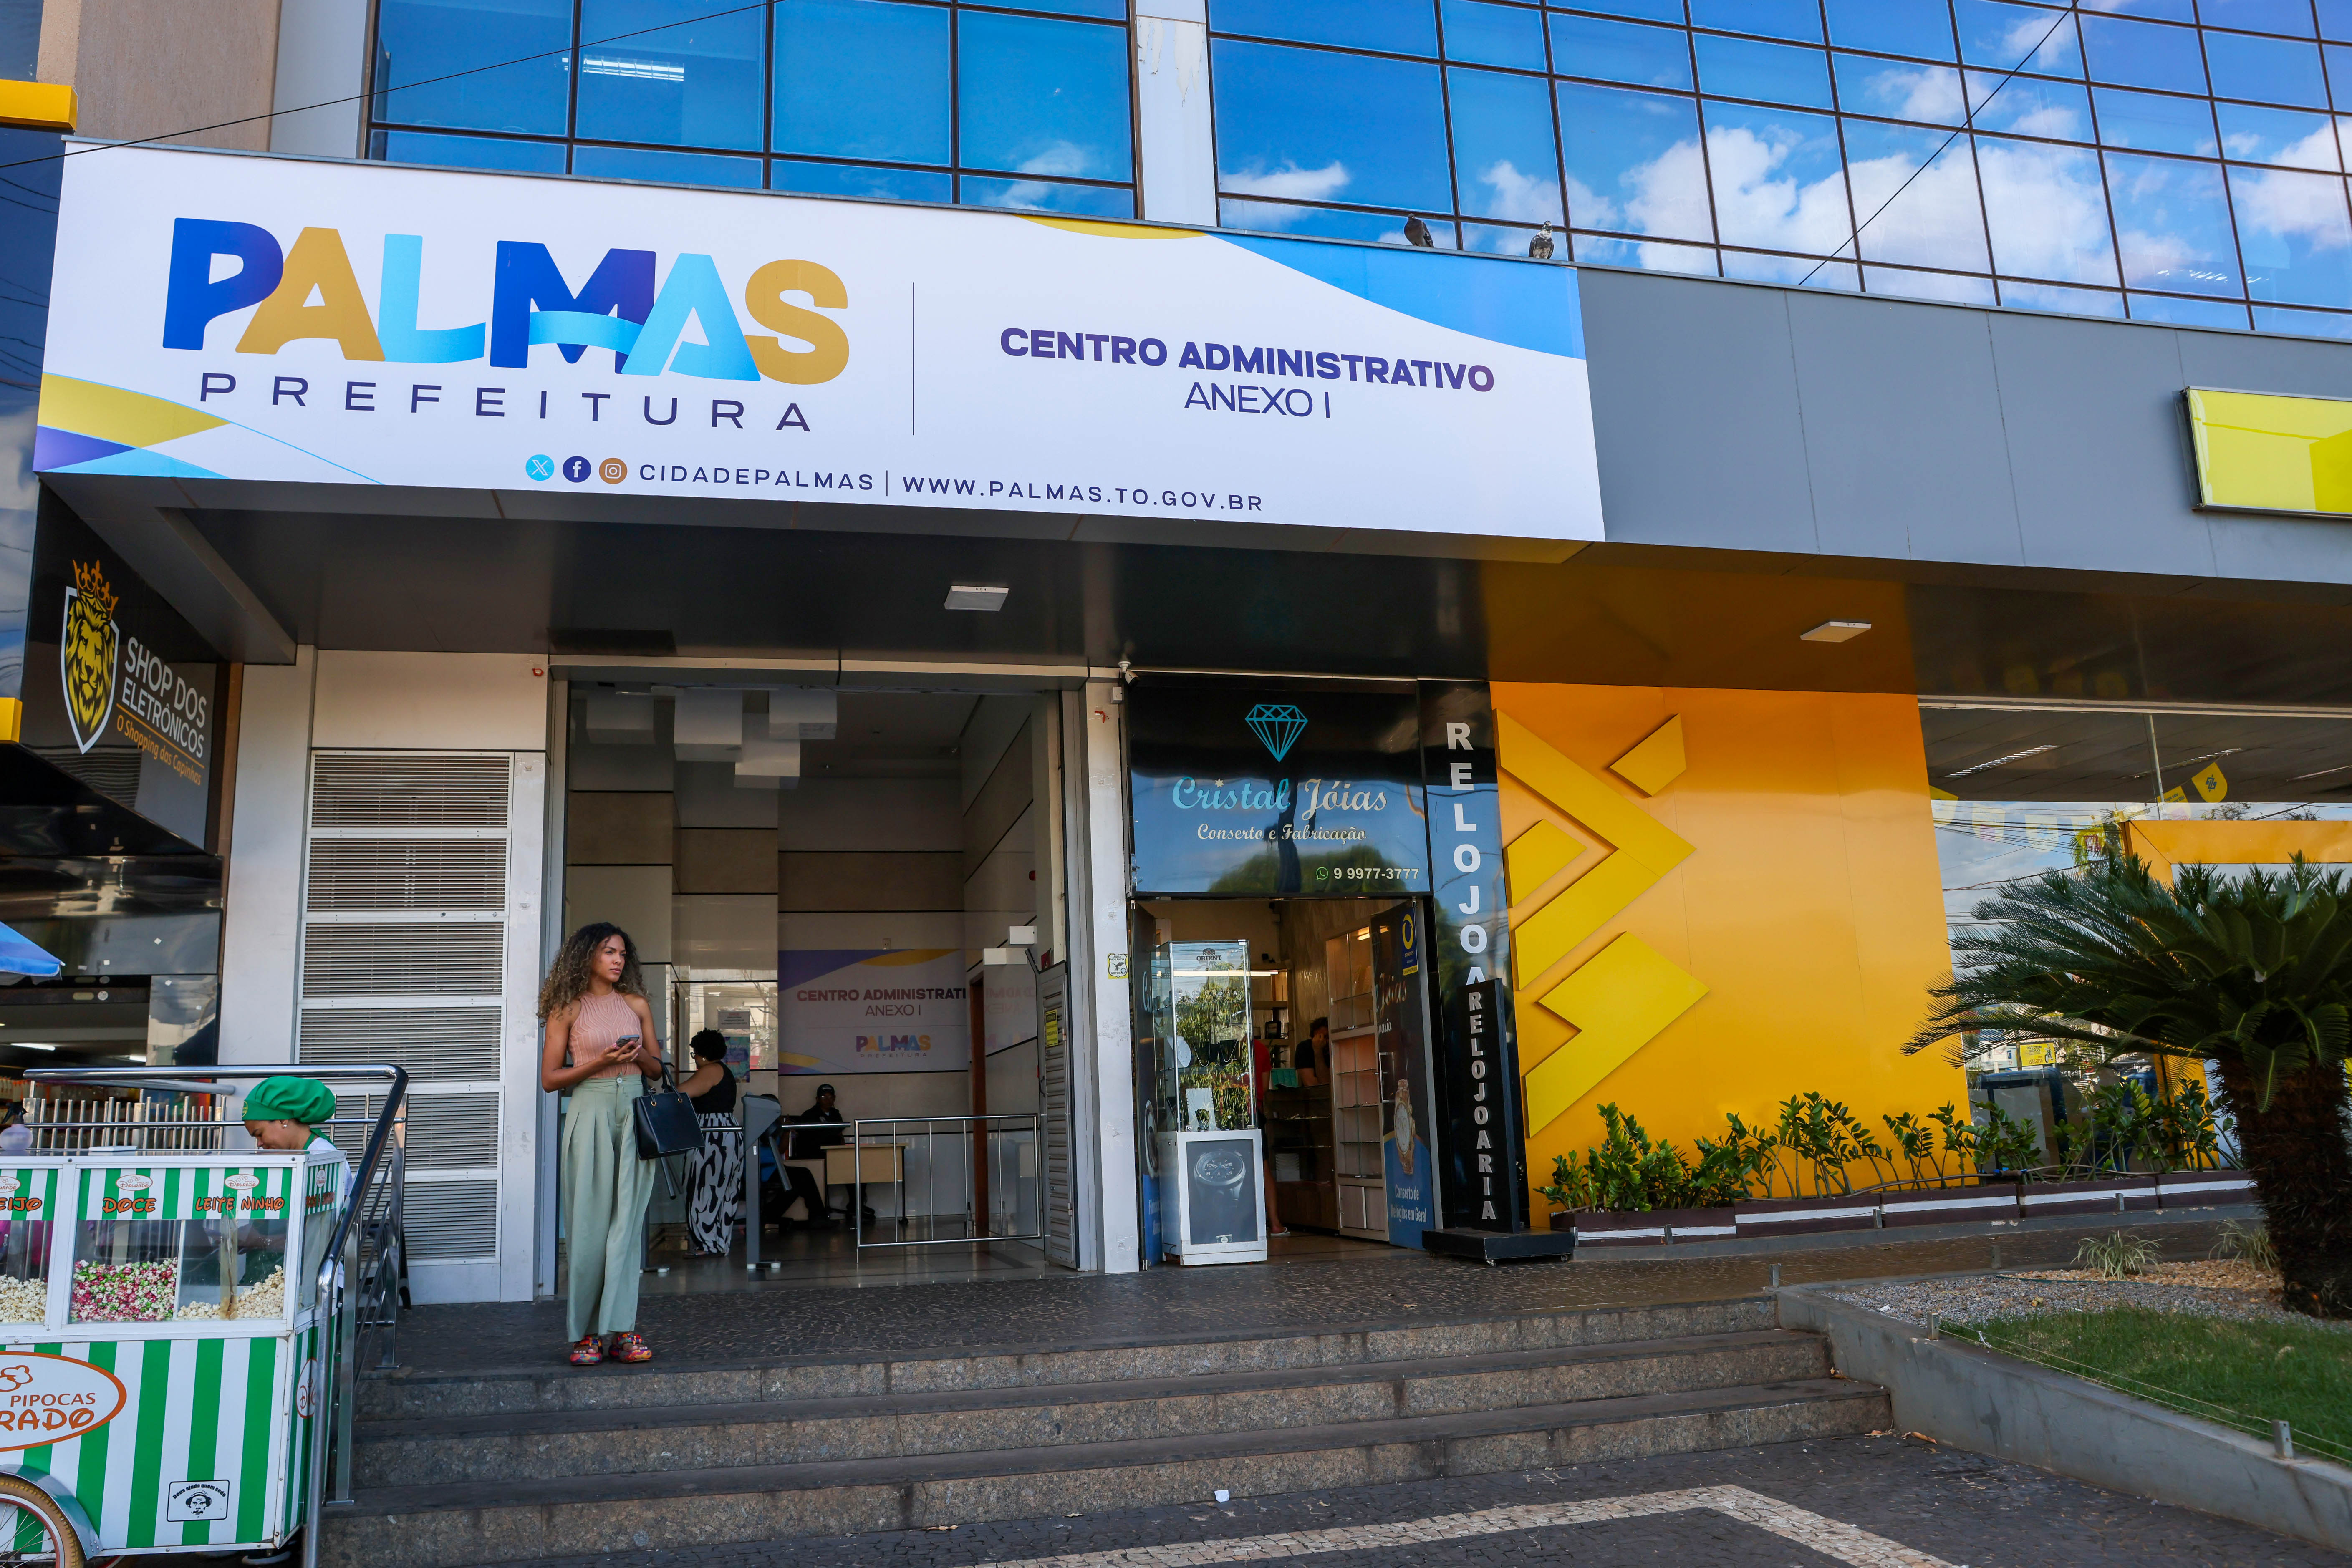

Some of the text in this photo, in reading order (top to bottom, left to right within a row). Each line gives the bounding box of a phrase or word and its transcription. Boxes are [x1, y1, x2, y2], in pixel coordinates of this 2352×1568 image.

[163, 218, 850, 385] PALMAS
[1000, 328, 1494, 392] CENTRO ADMINISTRATIVO
[200, 373, 811, 432] PREFEITURA
[1184, 382, 1330, 418] ANEXO I
[640, 464, 873, 490] CIDADEPALMAS
[903, 477, 1262, 511] WWW.PALMAS.TO.GOV.BR
[125, 636, 207, 728] SHOP DOS
[122, 676, 204, 758] ELETRÔNICOS
[117, 715, 202, 786] O Shopping das Capinhas
[1172, 776, 1387, 821] Cristal Jóias
[1197, 823, 1368, 845] Conserto e Fabricação
[1334, 868, 1419, 879] 9 9977-3777
[797, 988, 967, 1001] CENTRO ADMINISTRATI
[865, 1004, 921, 1016] ANEXO I
[856, 1034, 931, 1052] PALMAS
[1469, 991, 1497, 1220] RELOJOARIA
[102, 1197, 157, 1213] DOCE
[195, 1196, 285, 1213] LEITE NINHO
[1395, 1184, 1419, 1200] Conserto de
[1391, 1204, 1426, 1223] Relógios em Geral
[10, 1393, 96, 1407] PIPOCAS
